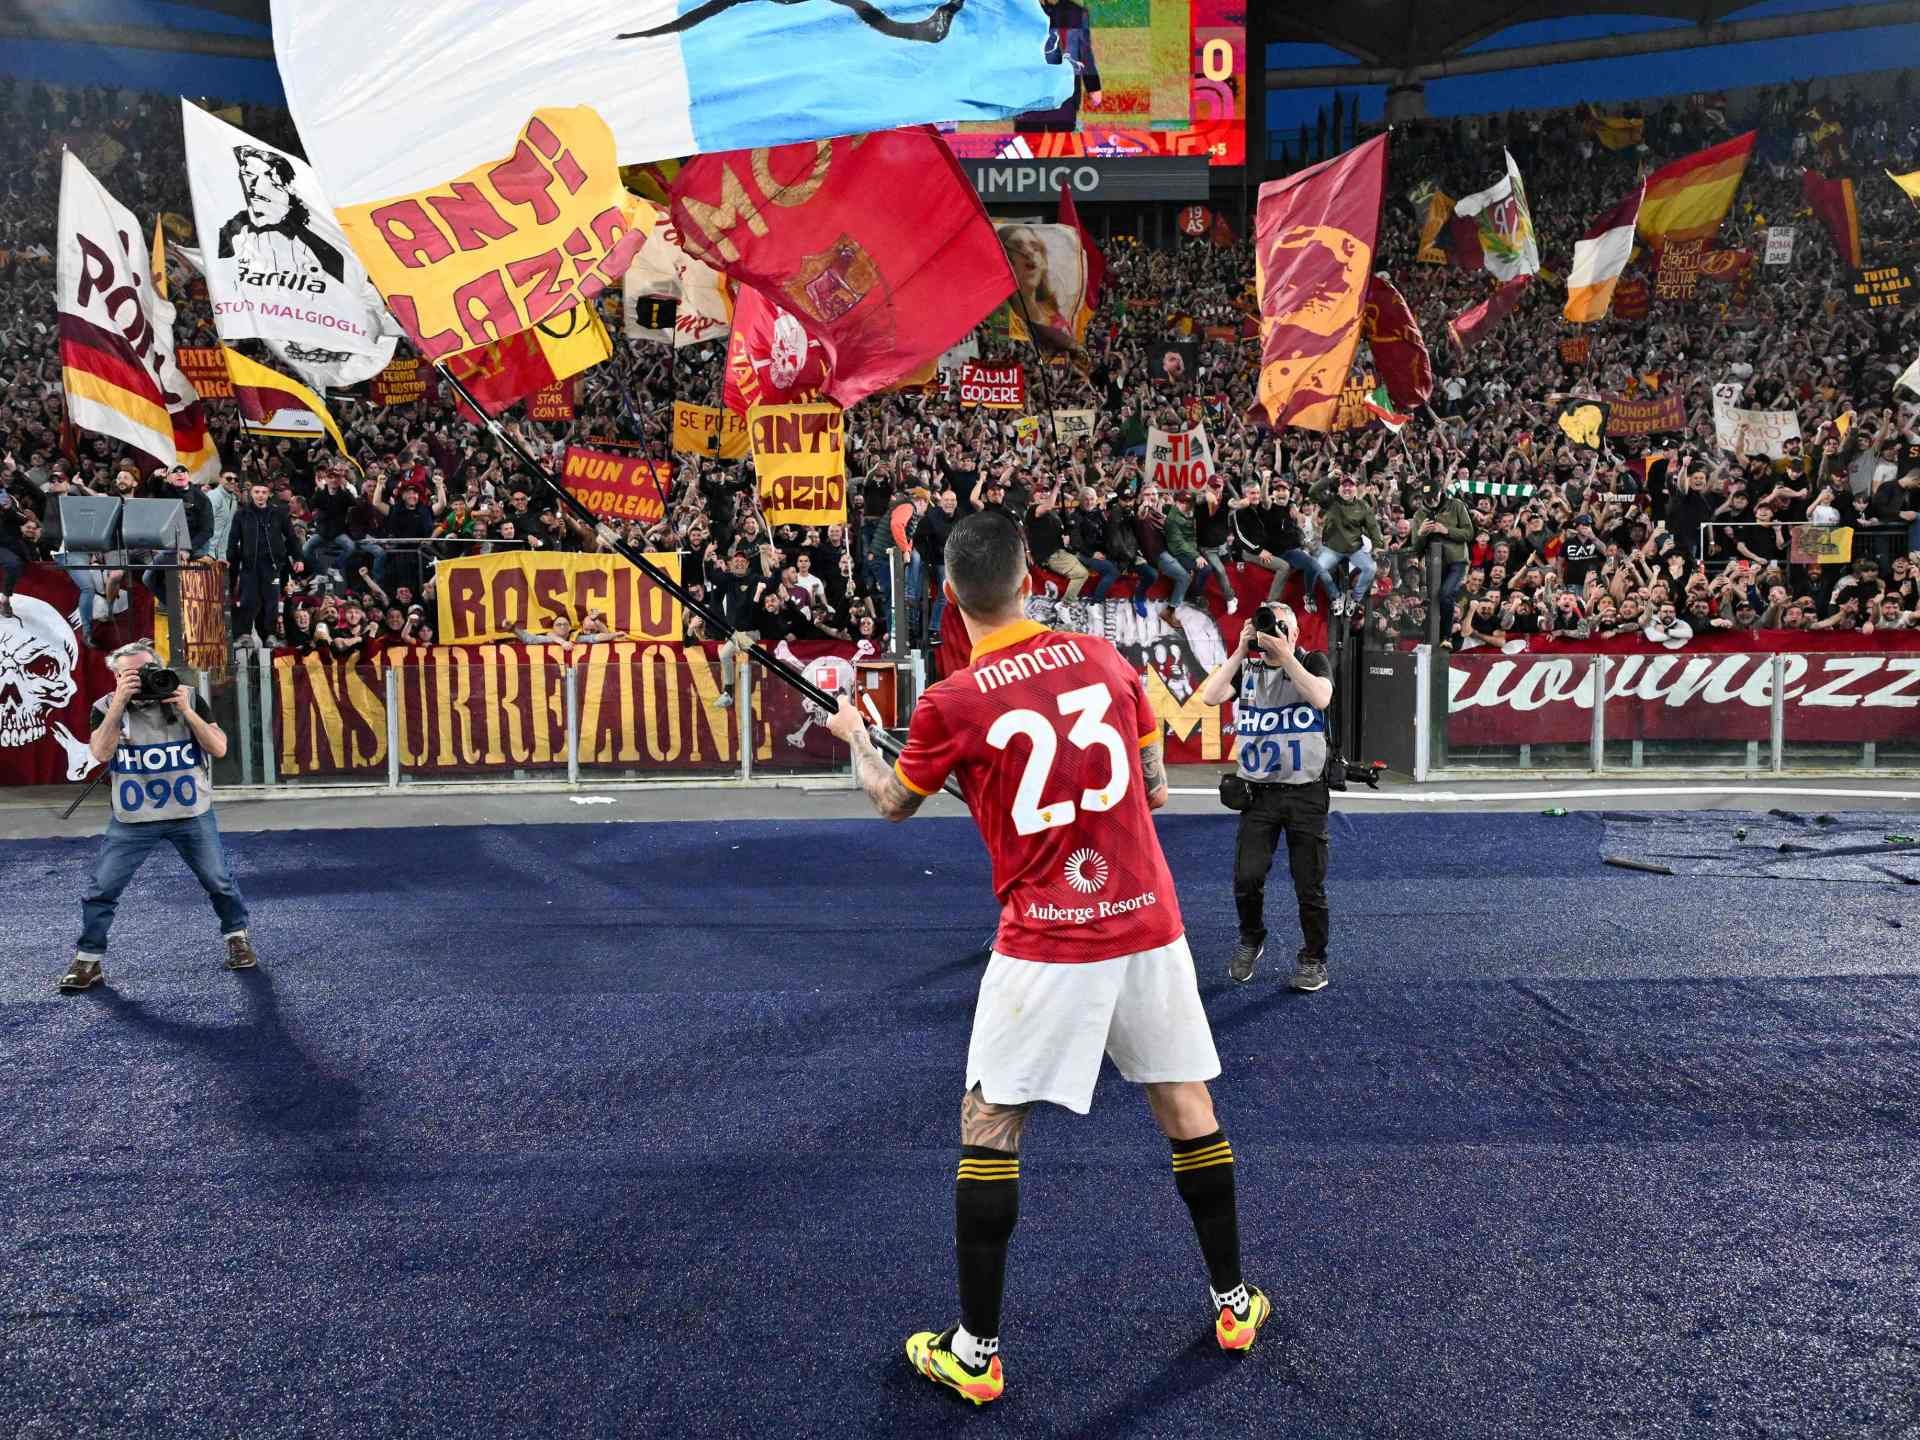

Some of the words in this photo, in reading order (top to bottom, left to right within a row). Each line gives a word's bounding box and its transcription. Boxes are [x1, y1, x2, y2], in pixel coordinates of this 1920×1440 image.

[1203, 39, 1233, 81] 0
[1864, 267, 1898, 282] TUTTO
[1872, 275, 1911, 292] PARLA
[536, 395, 562, 405] STAR
[961, 385, 1019, 402] GODERE
[533, 407, 556, 418] CON
[558, 407, 571, 417] TE
[680, 410, 699, 430] SE
[1168, 434, 1190, 462] TI
[567, 456, 624, 486] NUN
[1154, 460, 1207, 489] AMO
[1567, 544, 1596, 556] EA7
[449, 567, 672, 638] ROSCIO
[974, 640, 1085, 693] MANCINI
[274, 642, 773, 774] INSURREZIONE
[986, 682, 1130, 836] 23
[1241, 739, 1303, 773] 021
[120, 774, 198, 812] 090
[1025, 902, 1094, 925] Auberge
[1099, 891, 1156, 917] Resorts
